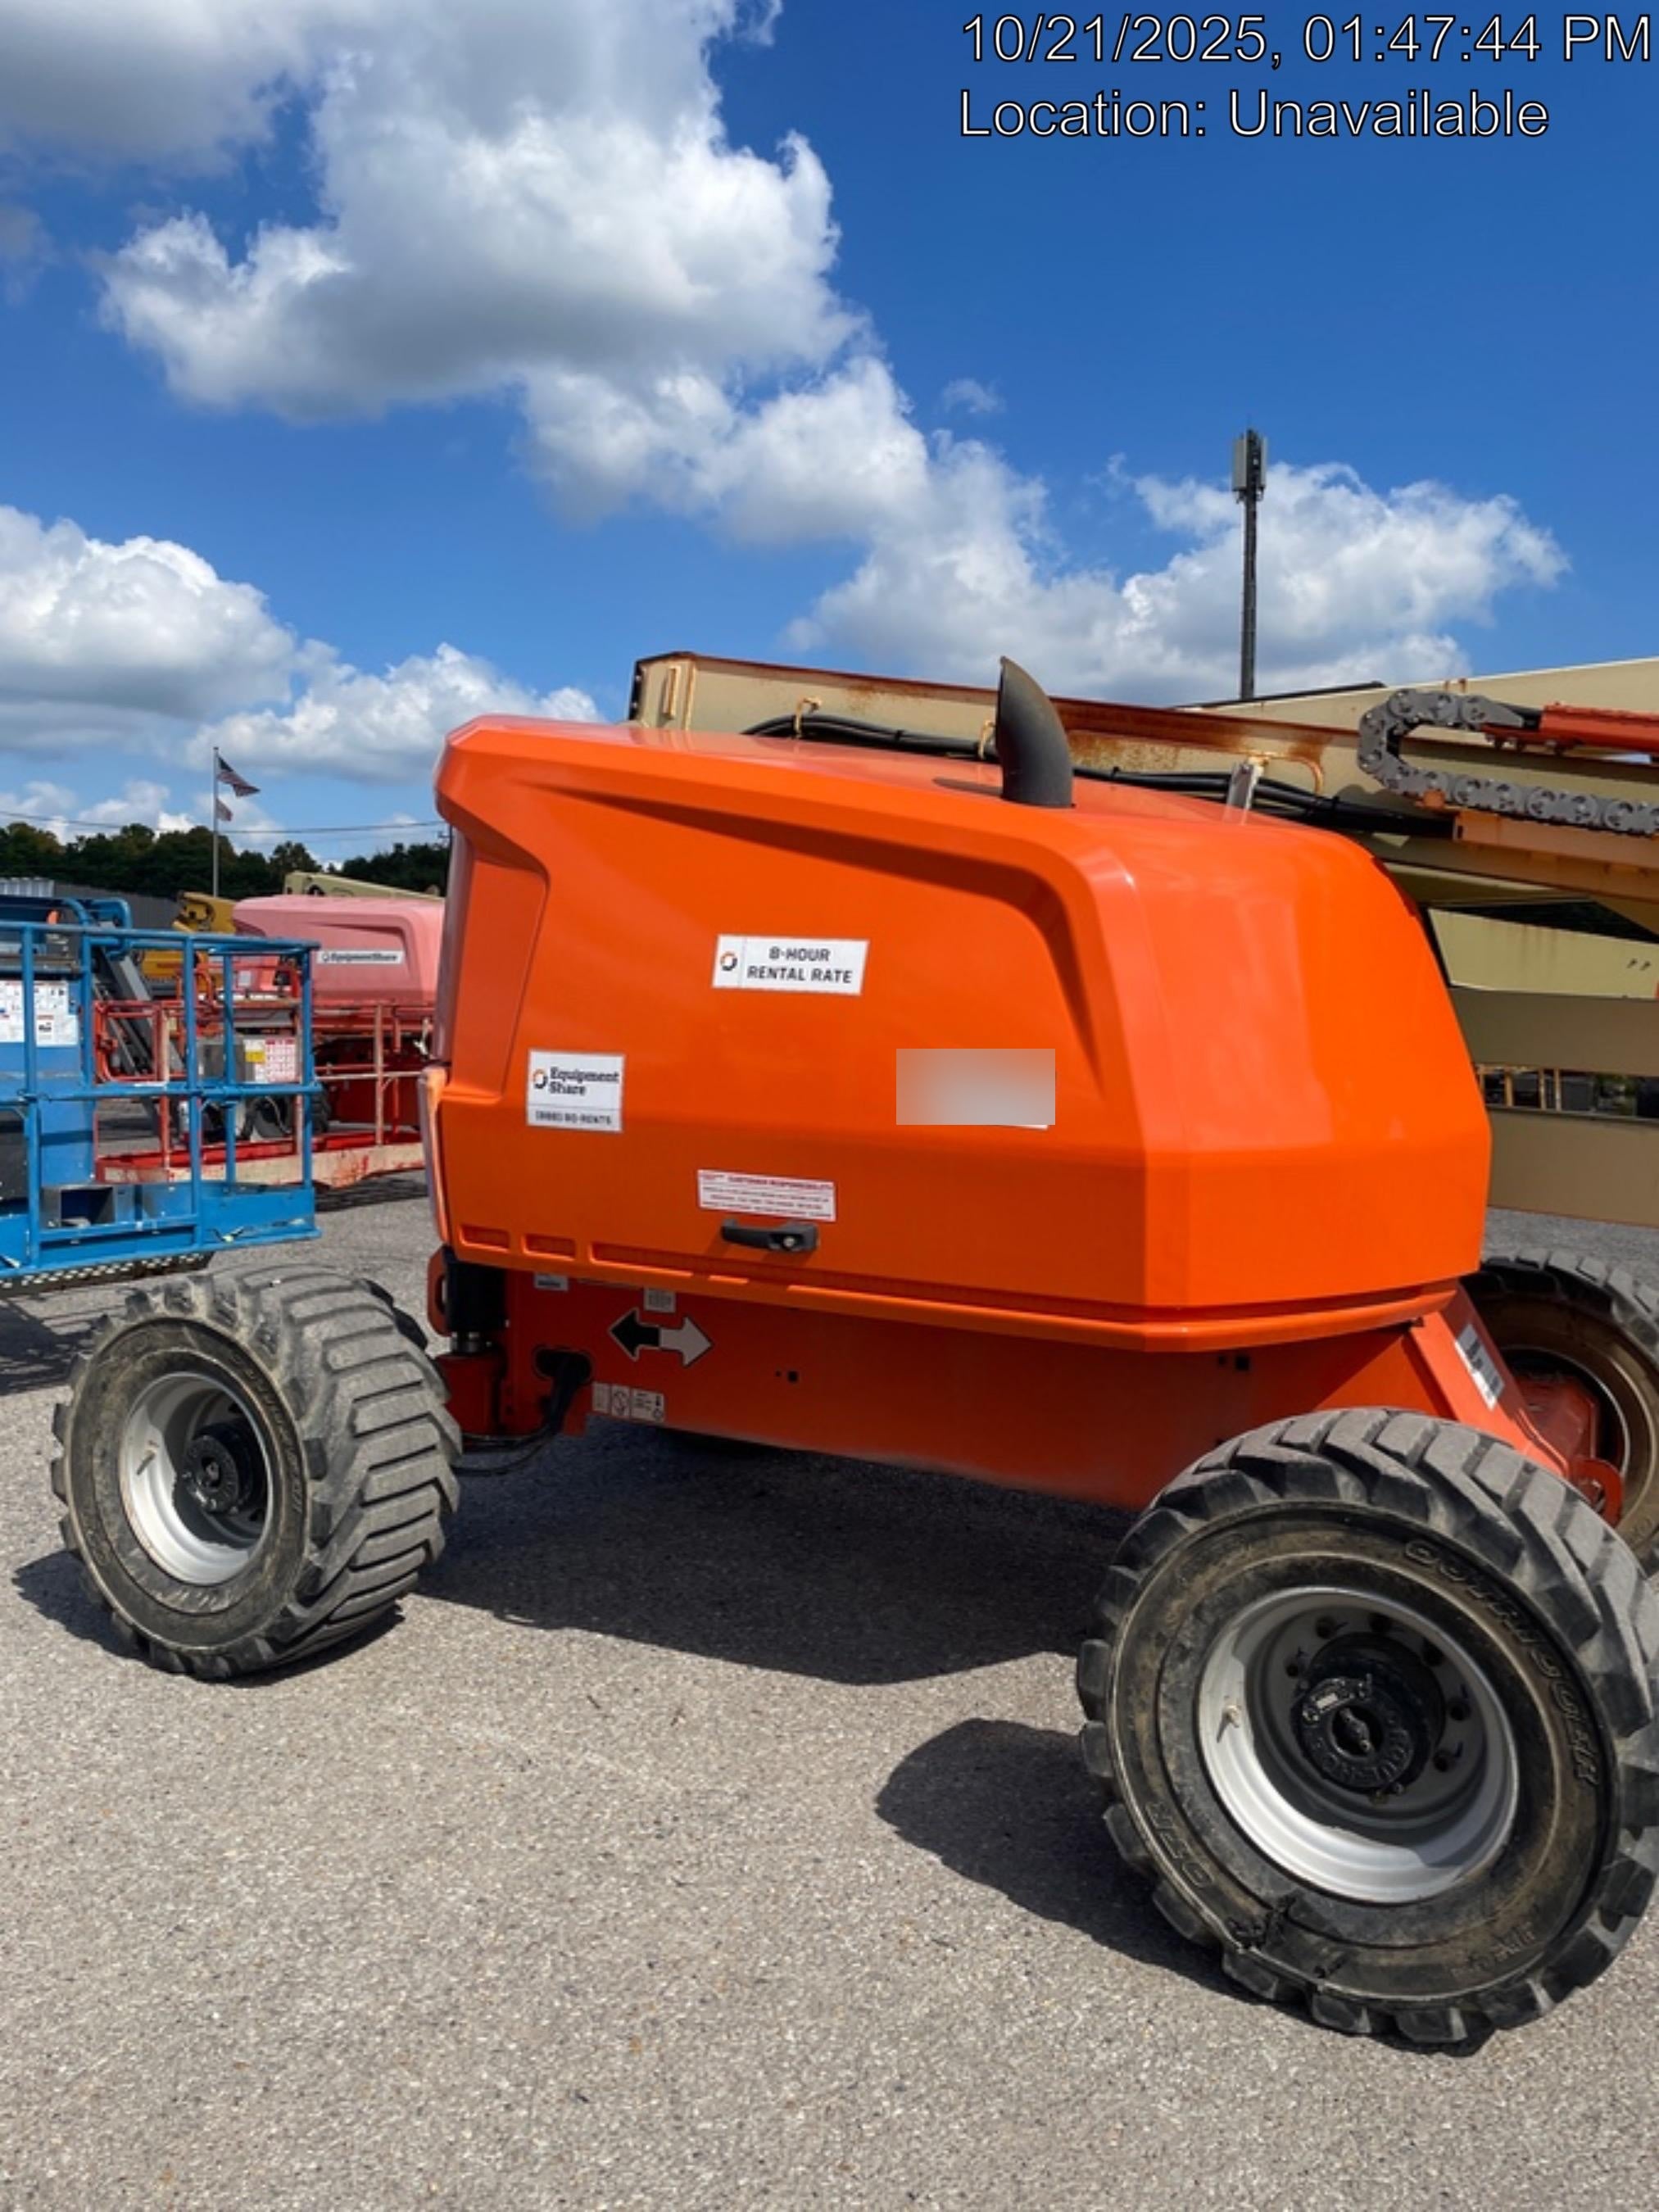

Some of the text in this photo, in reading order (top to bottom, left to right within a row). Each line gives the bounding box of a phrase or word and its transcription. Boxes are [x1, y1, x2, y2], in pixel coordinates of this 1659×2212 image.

[768, 945, 830, 962] 8-HOUR
[746, 965, 853, 984] RENTAL RATE
[550, 1066, 619, 1084] Equipment
[549, 1081, 587, 1095] Share
